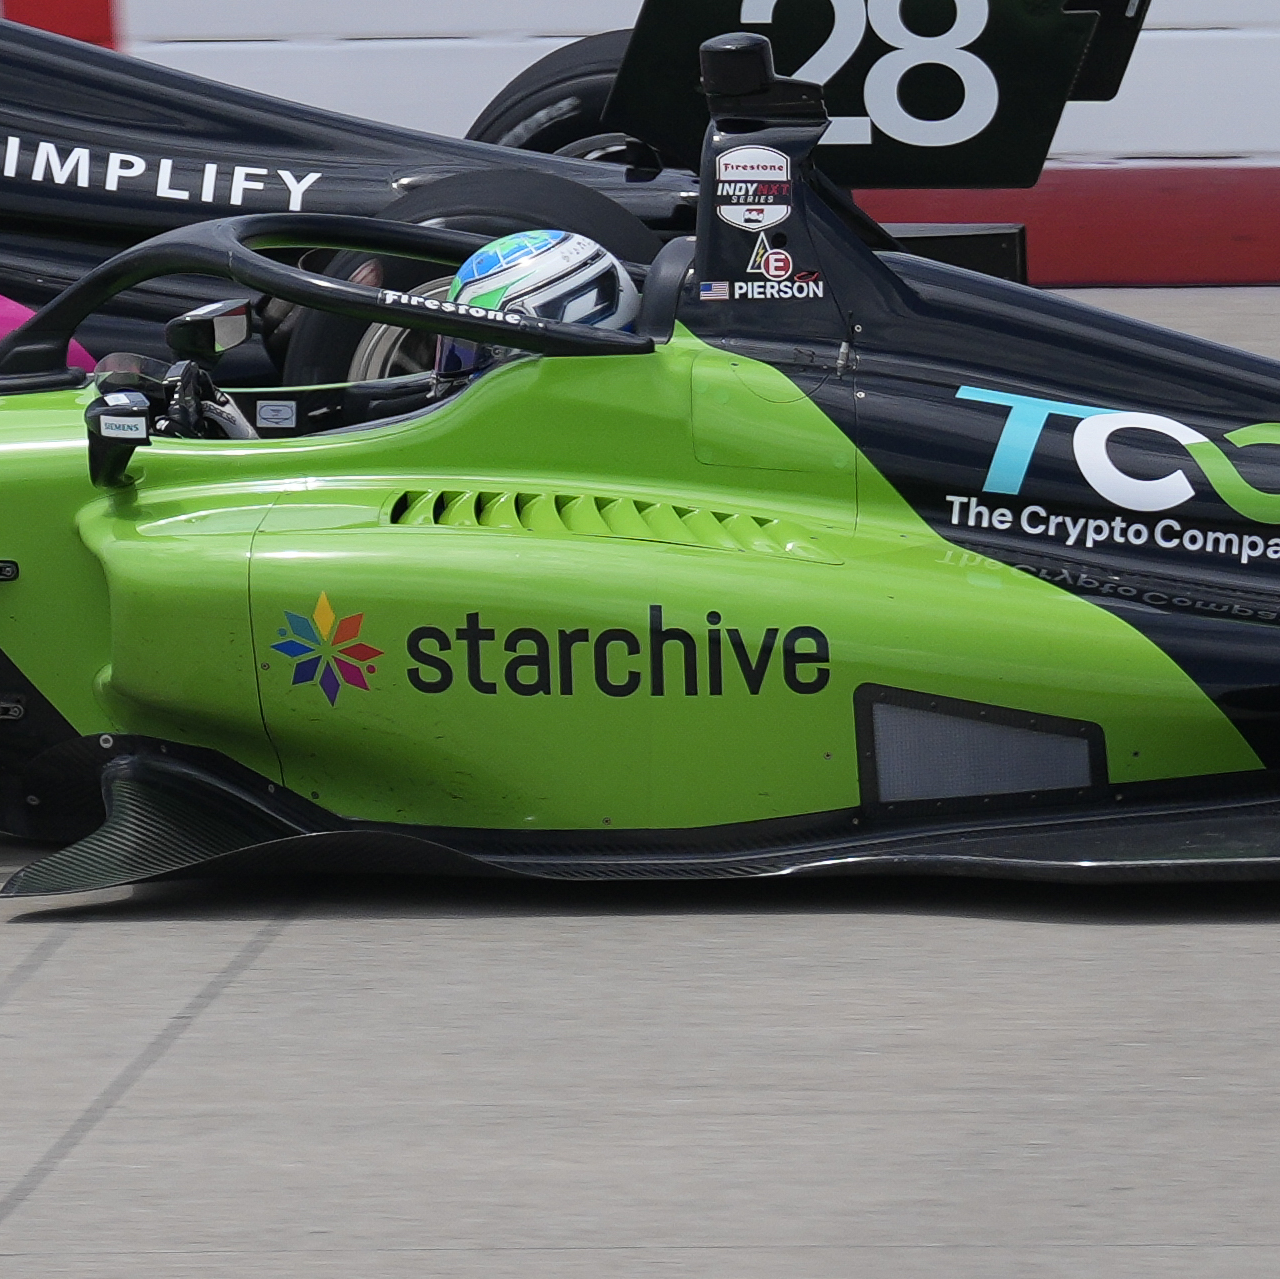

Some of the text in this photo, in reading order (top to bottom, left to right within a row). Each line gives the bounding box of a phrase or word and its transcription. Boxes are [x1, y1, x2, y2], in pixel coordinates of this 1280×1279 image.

[722, 162, 784, 172] Firestone
[716, 182, 790, 196] INDY NXT
[730, 195, 774, 203] SERIES
[734, 281, 823, 299] PIERSON
[384, 289, 522, 324] Firestone
[104, 422, 139, 432] SIEMENS
[945, 496, 1013, 530] The
[1020, 505, 1149, 548] Crypto
[406, 604, 829, 697] starchive
